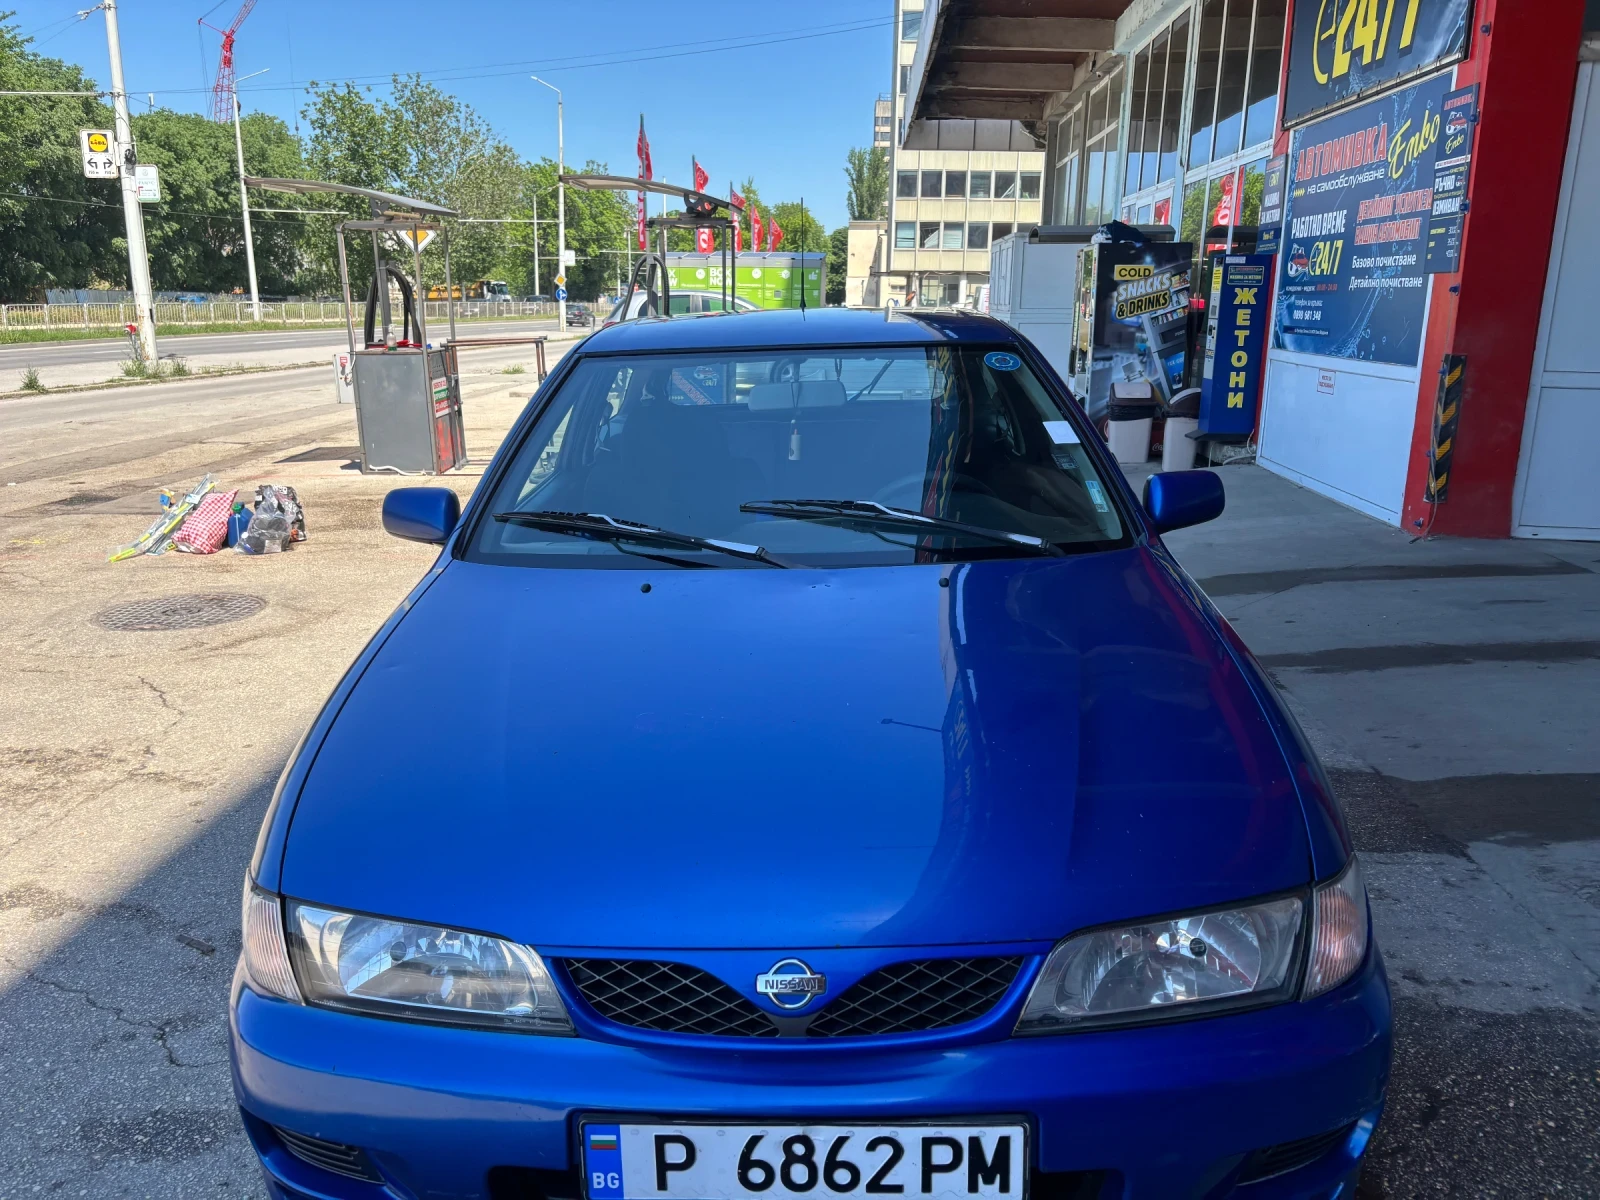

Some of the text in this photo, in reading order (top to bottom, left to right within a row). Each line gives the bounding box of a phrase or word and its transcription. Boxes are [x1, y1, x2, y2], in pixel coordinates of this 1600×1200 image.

[1295, 123, 1389, 182] АВТОМИВКА
[1307, 168, 1385, 195] на самообслужване
[1291, 214, 1322, 240] РАБОТНО
[1321, 209, 1348, 235] ВРЕМЕ
[1315, 239, 1344, 276] 24/7
[1352, 255, 1375, 269] Базово
[1375, 254, 1417, 268] почистване
[1118, 267, 1152, 278] COLD
[1118, 271, 1171, 301] SNACKS
[1348, 276, 1423, 291] Детайлно почистване
[1117, 292, 1168, 318] & DRINKS
[1225, 288, 1258, 409] ЖЕТОНИ
[765, 979, 819, 991] NISSAN
[653, 1133, 1012, 1195] P 6862 PM
[592, 1172, 621, 1190] BG
